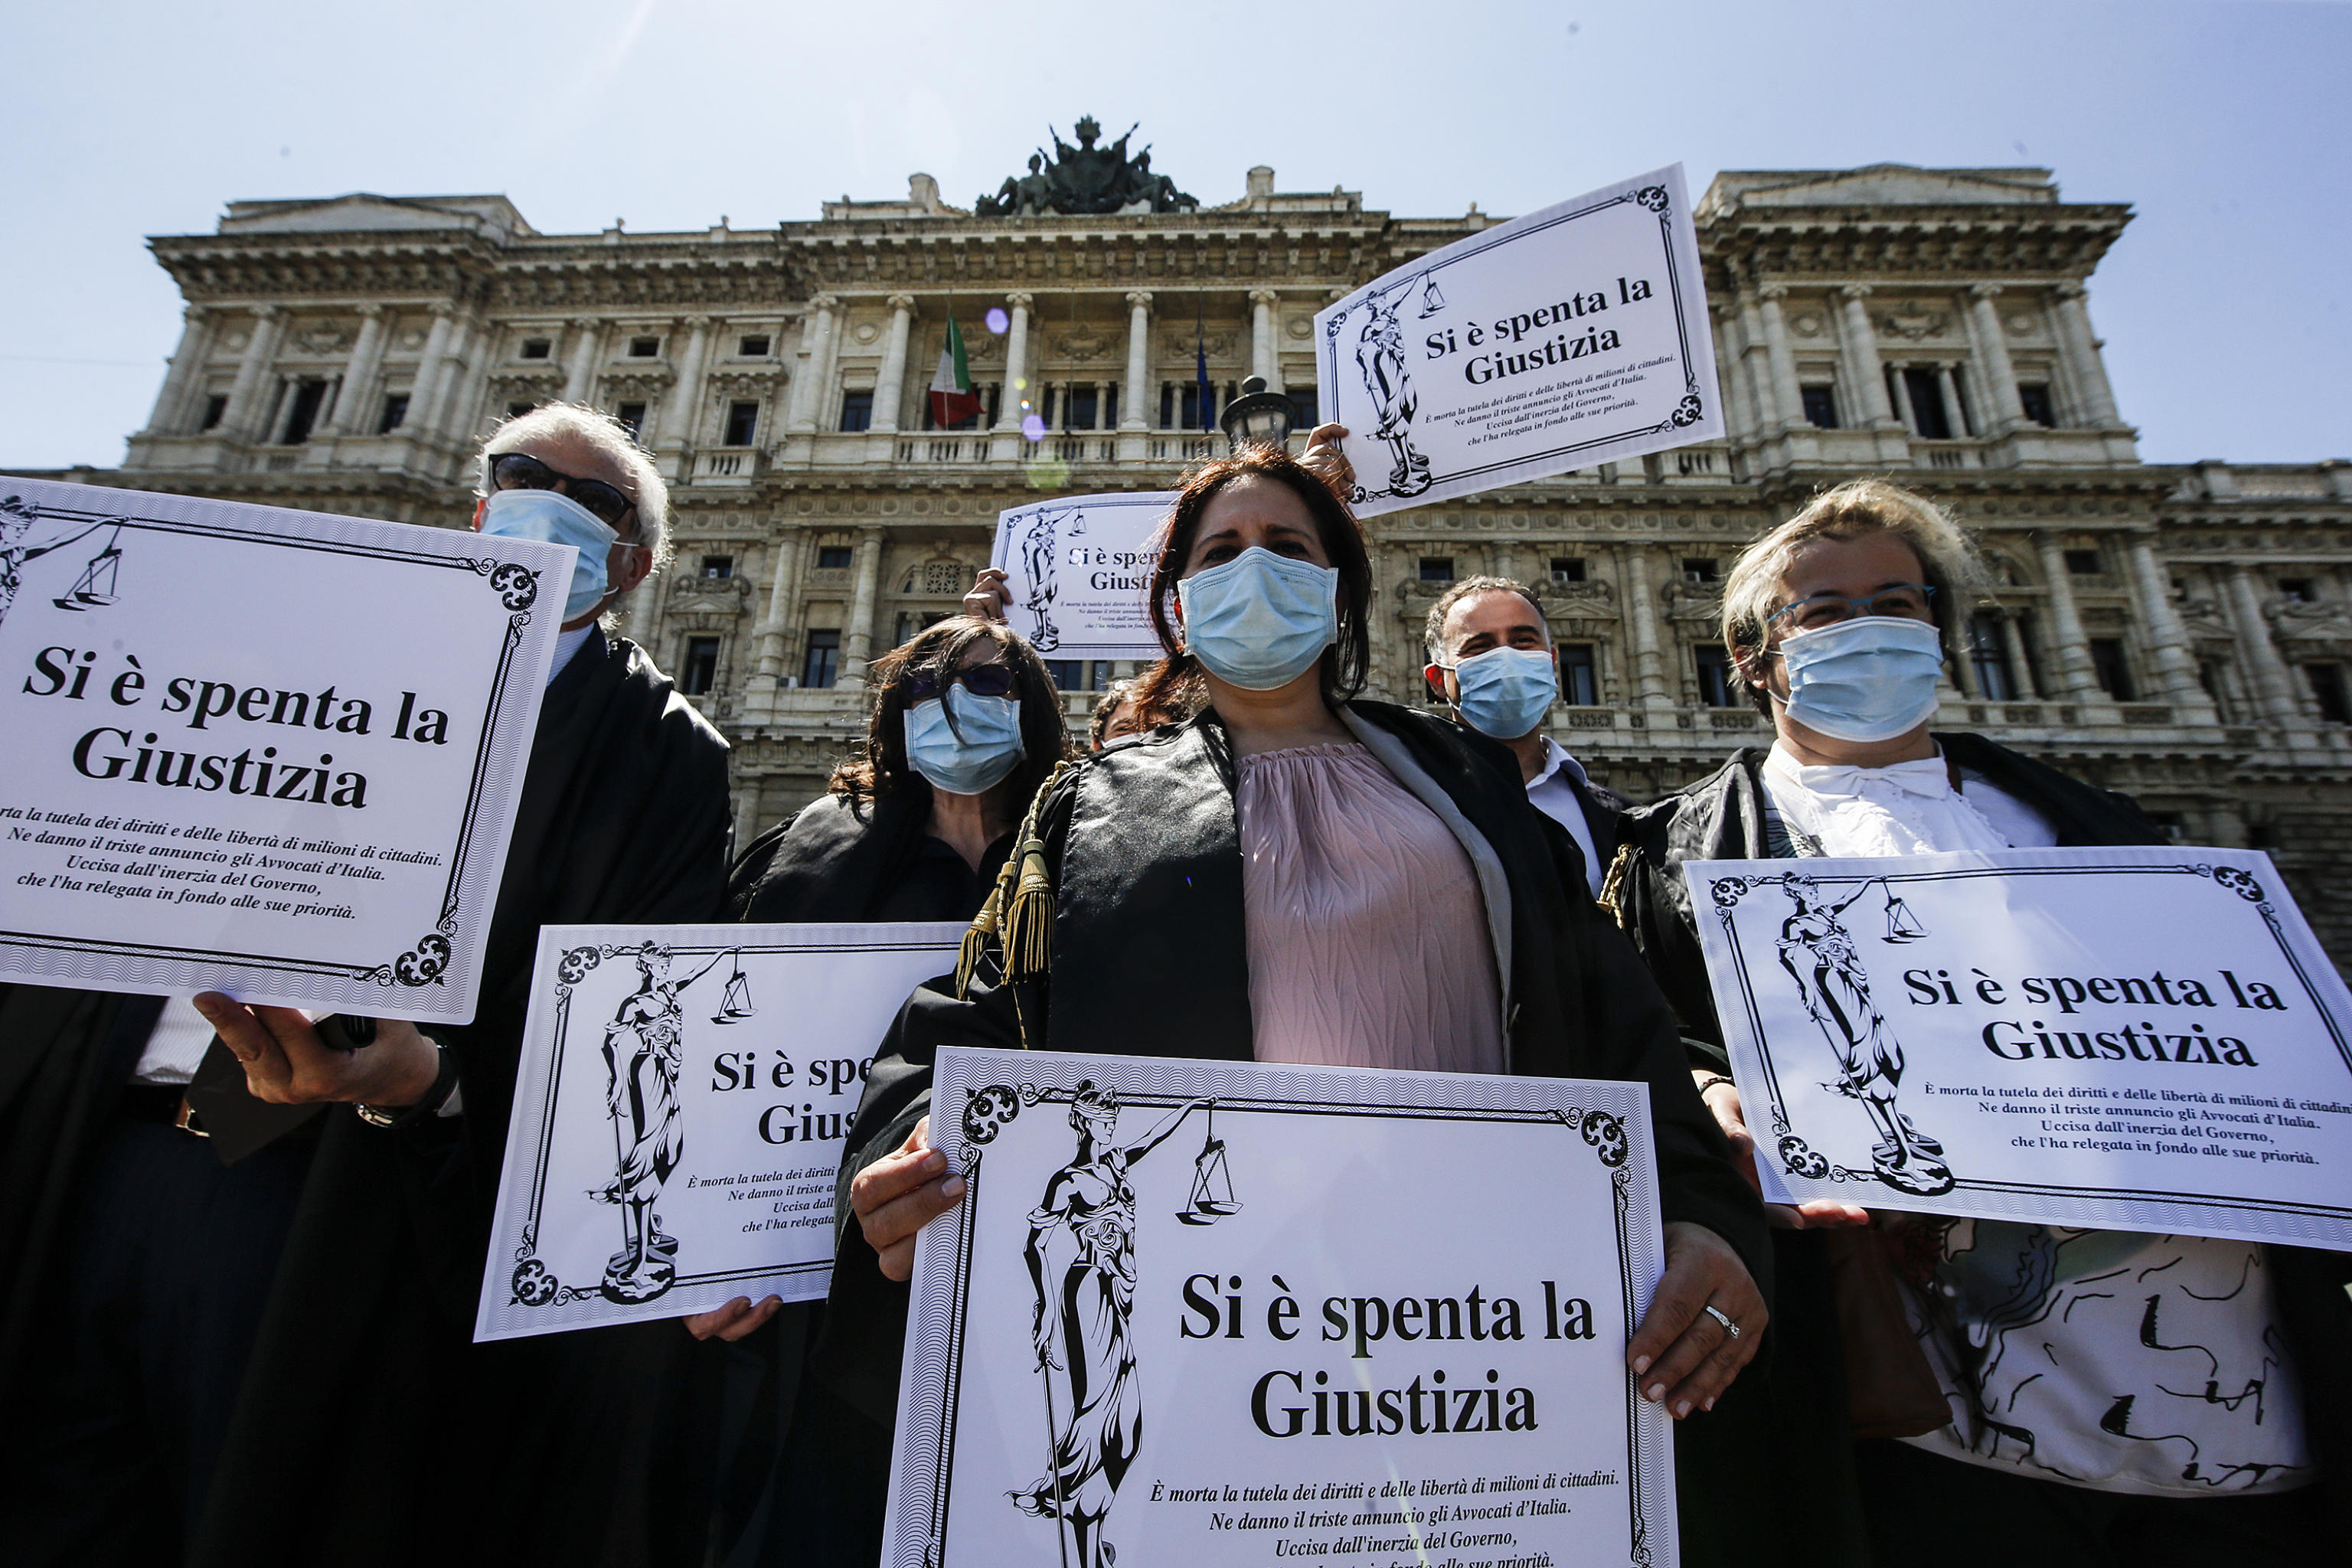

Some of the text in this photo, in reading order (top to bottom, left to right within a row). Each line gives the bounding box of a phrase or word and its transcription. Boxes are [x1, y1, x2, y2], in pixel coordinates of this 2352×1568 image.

[1426, 277, 1653, 360] Si è spenta la
[1465, 326, 1621, 384] Giustizia
[1426, 414, 1431, 423] È
[1434, 411, 1456, 421] morta
[1467, 401, 1489, 413] tutela
[1491, 397, 1503, 407] dei
[1504, 390, 1527, 403] diritti
[1535, 384, 1554, 395] delle
[1557, 377, 1583, 390] libertà
[1585, 374, 1592, 383] di
[1596, 368, 1625, 380] milioni
[1627, 363, 1635, 372] di
[1638, 354, 1675, 369] cittadini.
[1467, 413, 1491, 423] danno
[1494, 409, 1499, 417] il
[1501, 406, 1521, 416] triste
[1522, 395, 1561, 410] annuncio
[1563, 390, 1573, 401] gli
[1575, 383, 1610, 397] Avvocati
[1096, 547, 1107, 565] è
[1091, 572, 1155, 590] Giusti
[21, 646, 448, 745] Si è spenta la
[73, 727, 367, 808] Giustizia
[7, 827, 31, 841] Ne
[34, 830, 87, 848] danno
[90, 836, 104, 849] il
[105, 839, 145, 854] triste
[149, 847, 227, 863] annuncio
[230, 852, 254, 867] gli
[255, 855, 324, 873] Avvocati
[25, 807, 42, 821] la
[45, 812, 92, 826] tutela
[94, 815, 121, 829] dei
[122, 818, 169, 835] diritti
[170, 828, 180, 836] e
[183, 825, 223, 841] delle
[227, 830, 279, 848] libertà
[283, 837, 299, 850] di
[302, 840, 358, 856] milioni
[360, 845, 377, 858] di
[378, 848, 441, 866] cittadini.
[17, 872, 354, 919] che l'ha relegata in fondo alle sue priorità.
[67, 854, 321, 897] Uccisa dall'inerzia del Governo,
[1903, 968, 2288, 1014] Si è spenta la
[1981, 1021, 2259, 1067] Giustizia
[711, 1050, 874, 1096] Si è spe
[1925, 1081, 1935, 1094] È
[1939, 1087, 1978, 1096] morta
[1982, 1086, 1995, 1096] la
[1999, 1086, 2038, 1097] tutela
[2043, 1087, 2063, 1097] dei
[2068, 1087, 2108, 1098] diritti
[2124, 1088, 2157, 1100] delle
[2161, 1089, 2208, 1102] libertà
[2211, 1093, 2225, 1104] di
[2229, 1095, 2279, 1108] milioni
[2282, 1098, 2297, 1109] di
[2299, 1099, 2352, 1114] cittadini
[1978, 1102, 1998, 1112] Ne
[2002, 1102, 2046, 1113] danno
[2050, 1103, 2060, 1114] il
[2064, 1104, 2100, 1115] triste
[2105, 1106, 2174, 1118] annuncio
[2177, 1108, 2197, 1122] gli
[2200, 1109, 2260, 1123] Avvocati
[2011, 1136, 2319, 1165] che l'ha relegata in fondo alle sue priorità.
[2041, 1120, 2274, 1145] Uccisa dall'inerzia del Governo,
[688, 1166, 835, 1189] È morta la tutela dei diritti
[727, 1190, 744, 1201] Ne
[747, 1188, 783, 1199] danno
[786, 1185, 795, 1196] il
[796, 1184, 824, 1194] triste
[1181, 1274, 1596, 1358] Si è spenta la
[1251, 1369, 1538, 1438] Giustizia
[1149, 1469, 1619, 1501] È morta la tutela dei diritti e delle libertà di milioni di cittadini.
[1209, 1513, 1233, 1530] Ne
[1237, 1512, 1289, 1530] danno
[1294, 1511, 1305, 1528] il
[1308, 1510, 1348, 1527] triste
[1352, 1507, 1425, 1526] annuncio
[1428, 1505, 1449, 1527] gli
[1450, 1501, 1512, 1521] Avvocati
[1276, 1530, 1517, 1557] Uccisa dall'inerzia del Governo,
